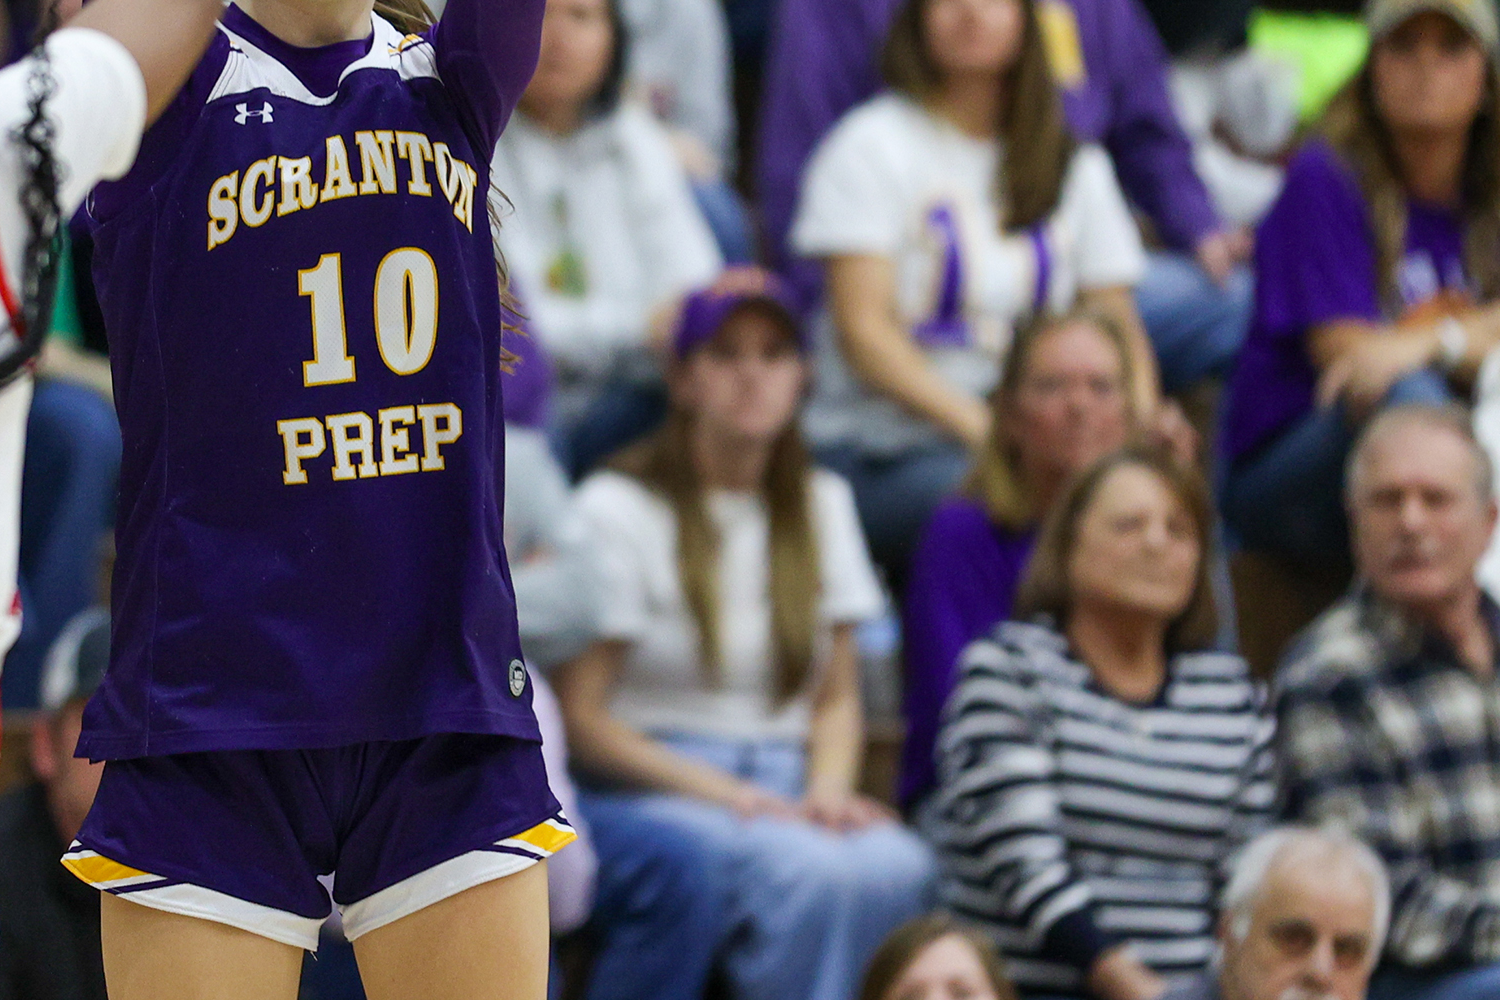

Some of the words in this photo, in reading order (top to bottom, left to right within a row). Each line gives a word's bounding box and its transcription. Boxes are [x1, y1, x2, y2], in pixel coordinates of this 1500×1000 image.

[206, 130, 478, 251] SCRANTON
[297, 246, 439, 388] 10
[276, 402, 463, 486] PREP
